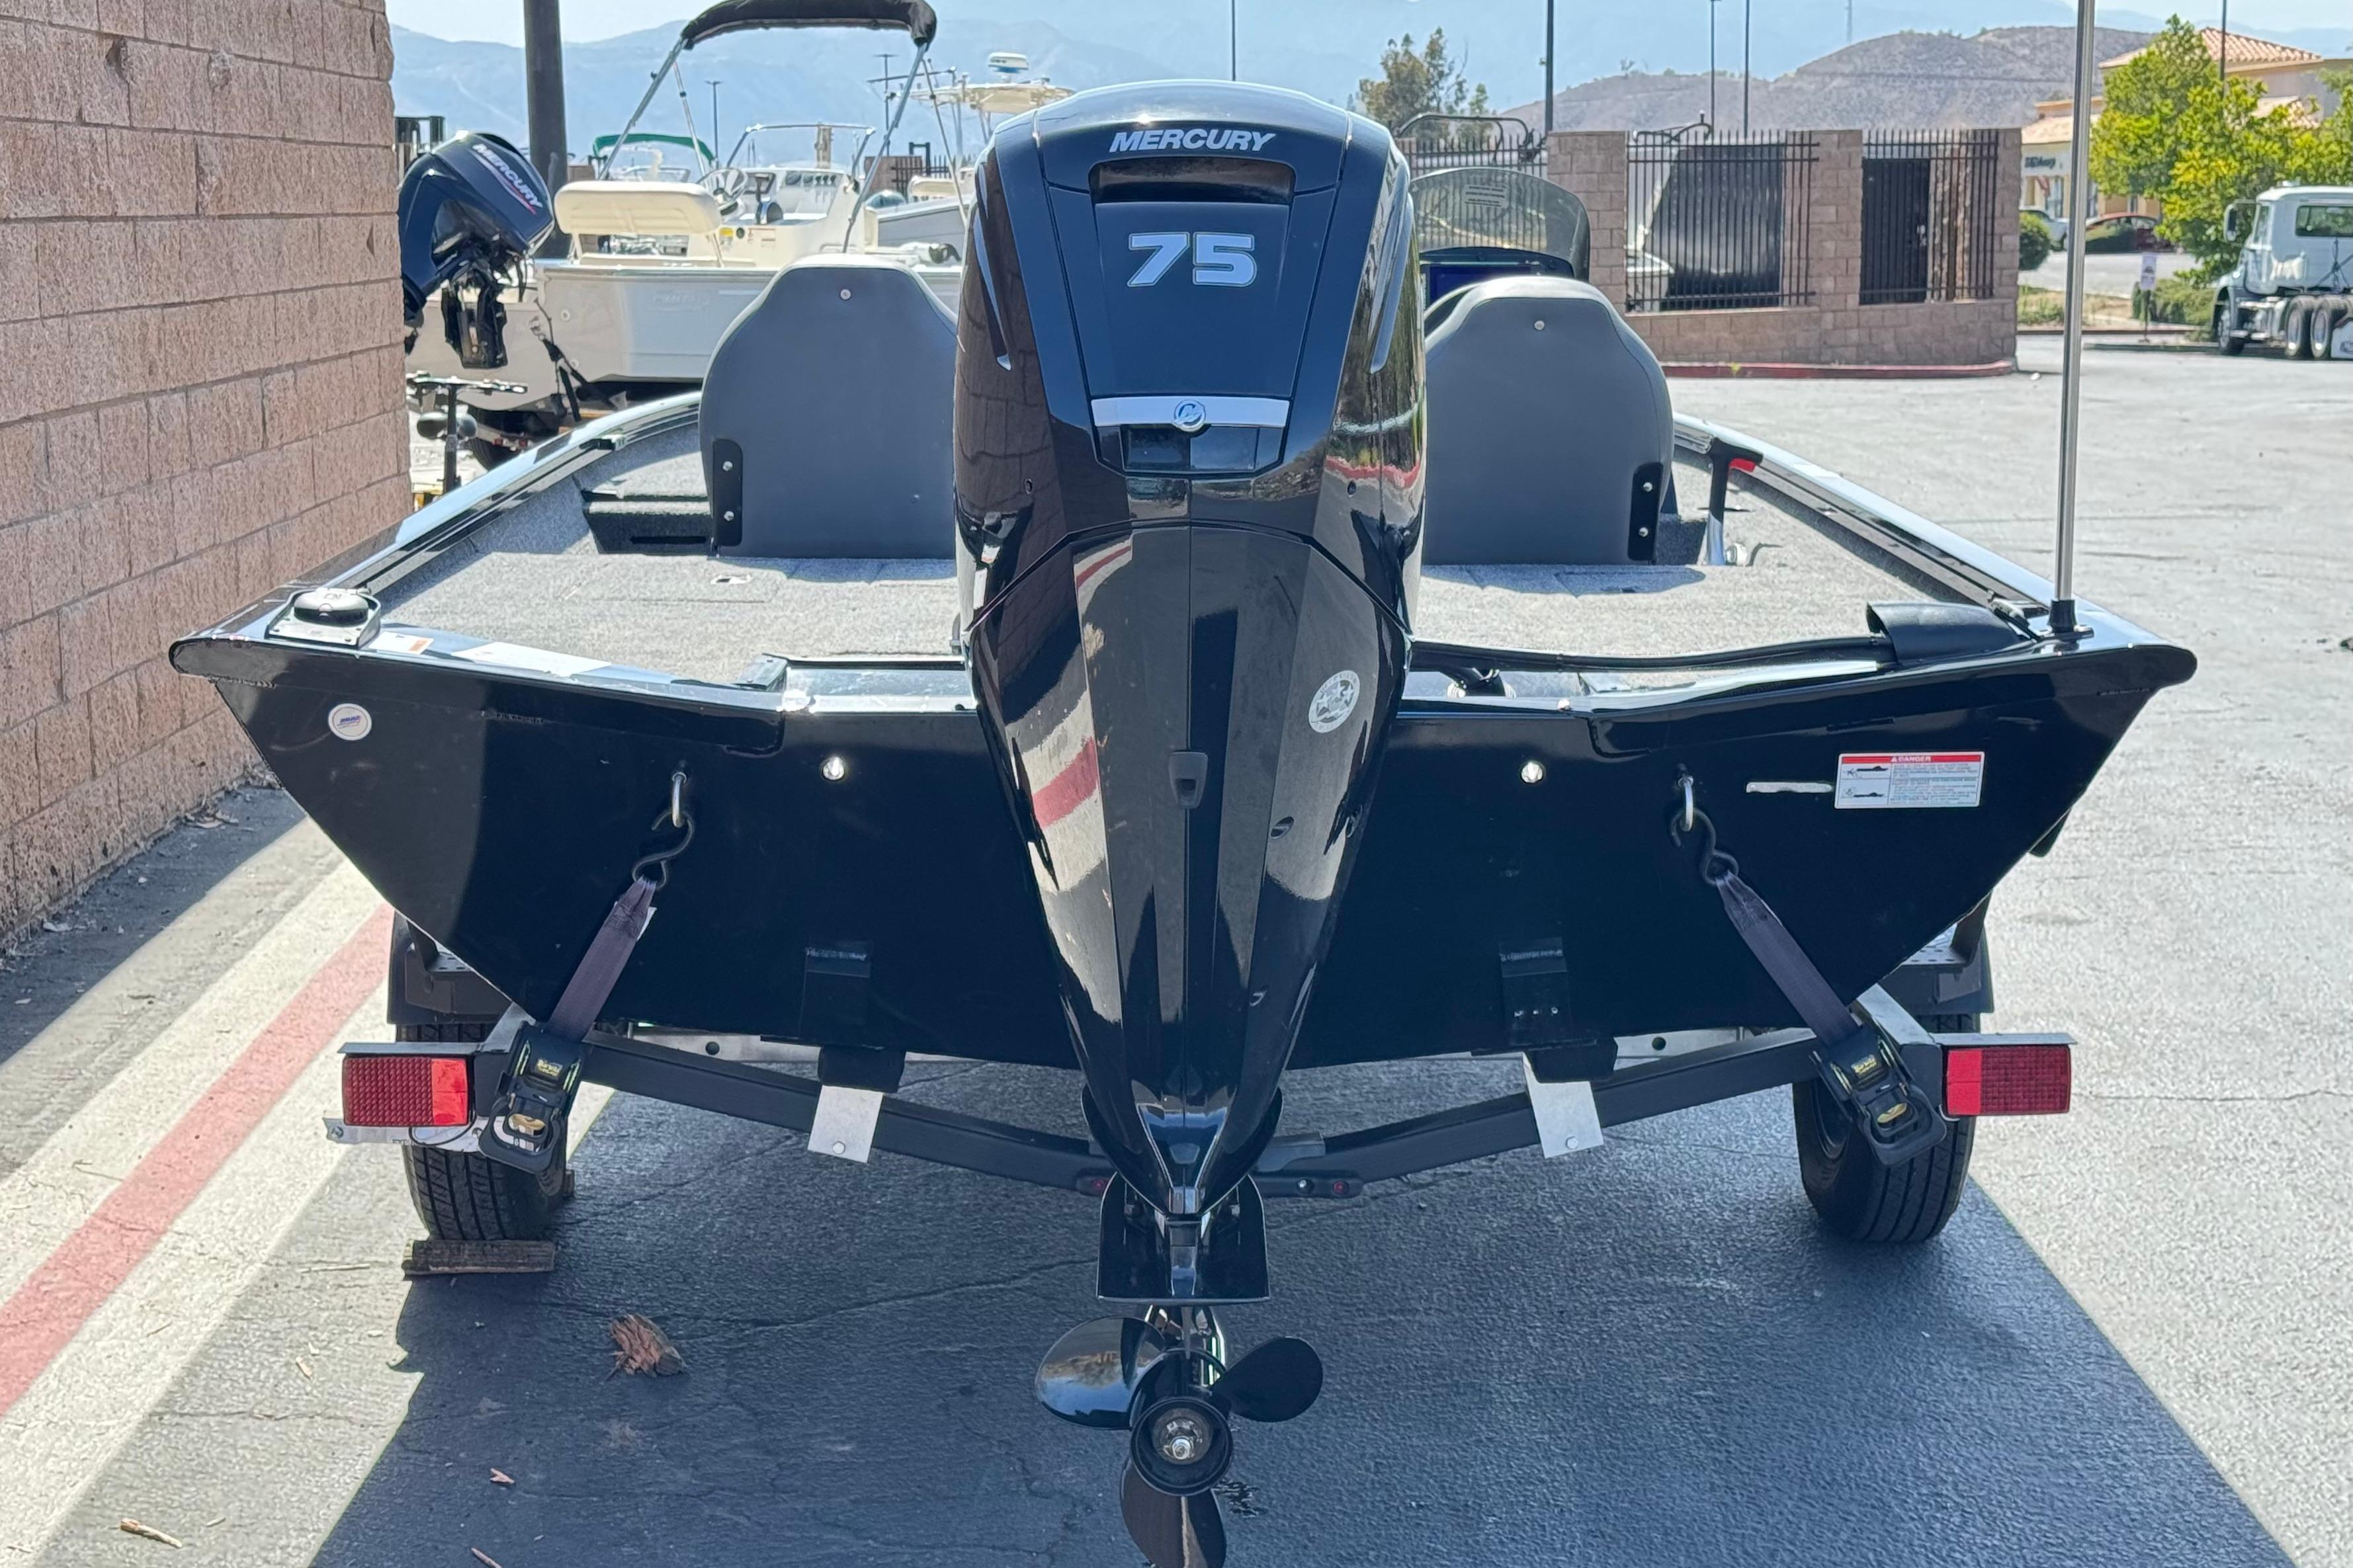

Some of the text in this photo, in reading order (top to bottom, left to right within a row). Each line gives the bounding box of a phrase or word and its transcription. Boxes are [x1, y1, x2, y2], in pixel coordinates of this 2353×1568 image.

[1109, 129, 1275, 152] MERCURY
[472, 144, 543, 208] MERCURY
[1127, 232, 1256, 287] 75
